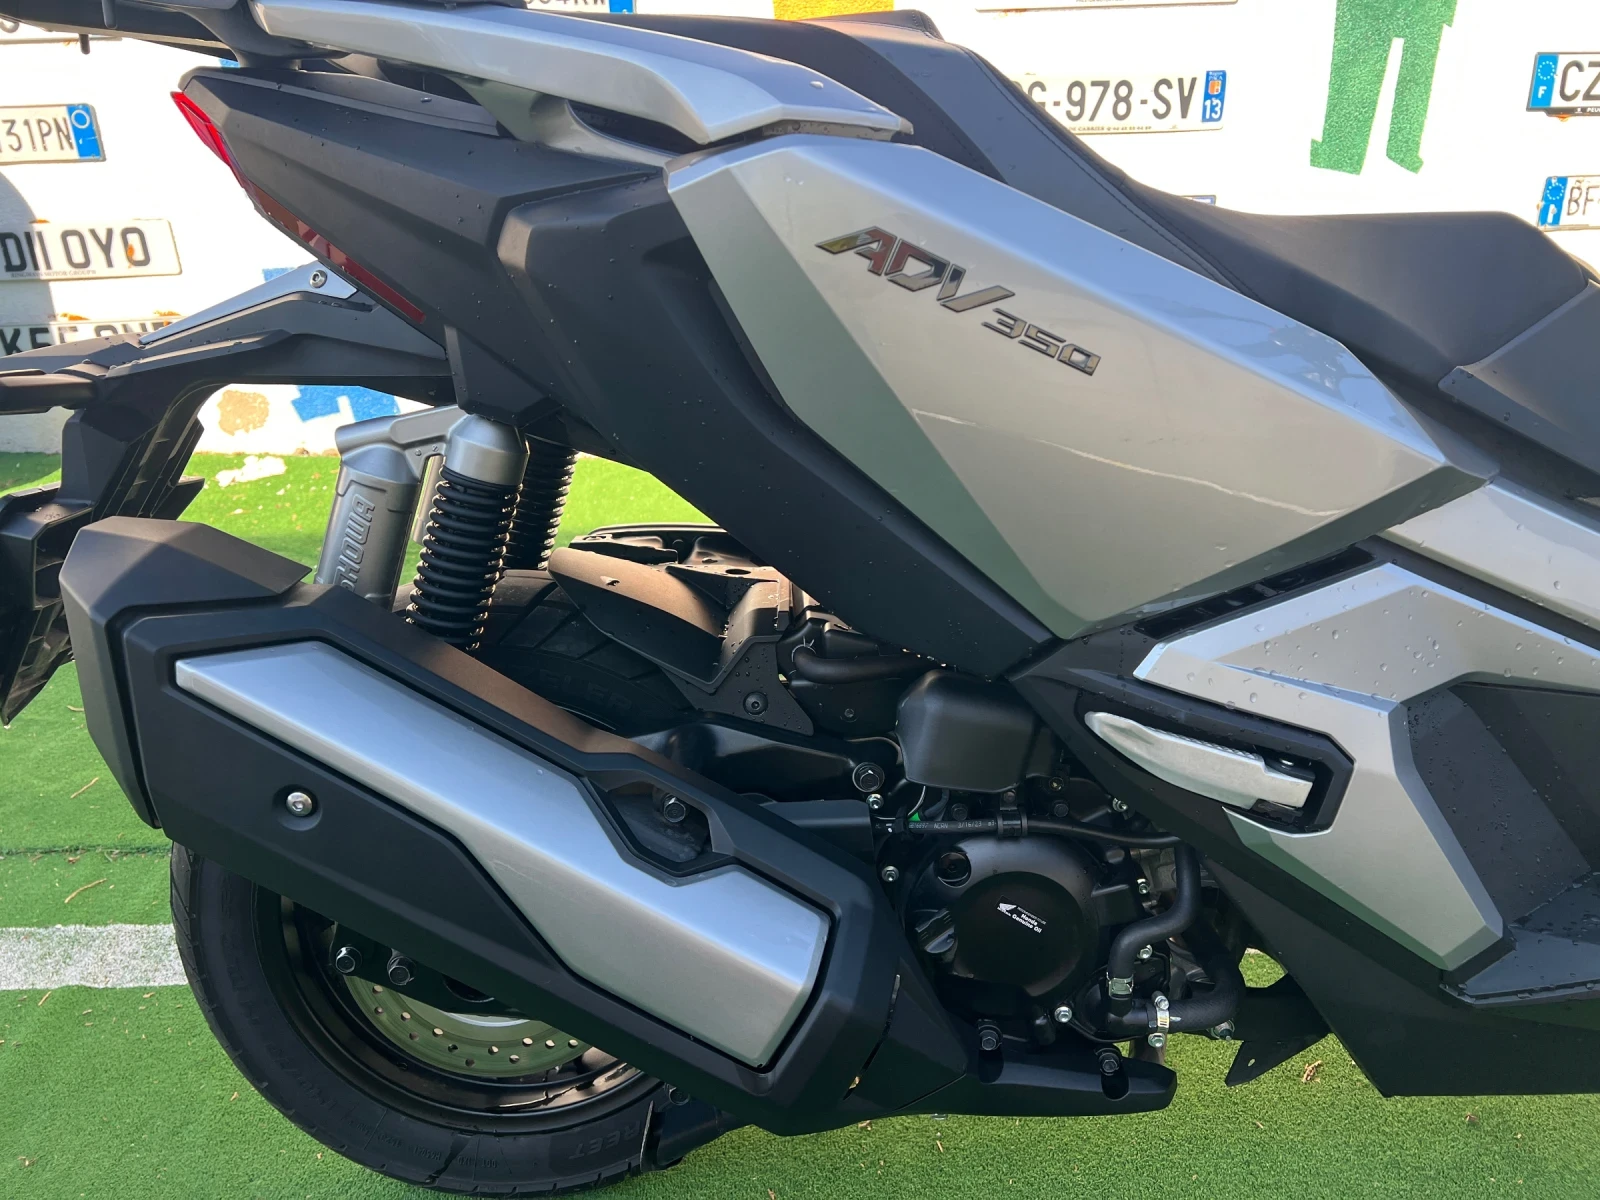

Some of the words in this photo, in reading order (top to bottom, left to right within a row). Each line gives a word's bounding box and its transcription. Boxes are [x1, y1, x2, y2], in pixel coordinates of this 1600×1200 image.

[1013, 77, 1197, 122] G-978-SV
[1204, 98, 1222, 119] 13
[61, 227, 151, 269] OYO
[815, 226, 1015, 313] ADV
[981, 307, 1101, 376] 350
[1012, 913, 1034, 929] Genuine
[1033, 926, 1043, 934] Oil
[1020, 913, 1038, 926] Honda
